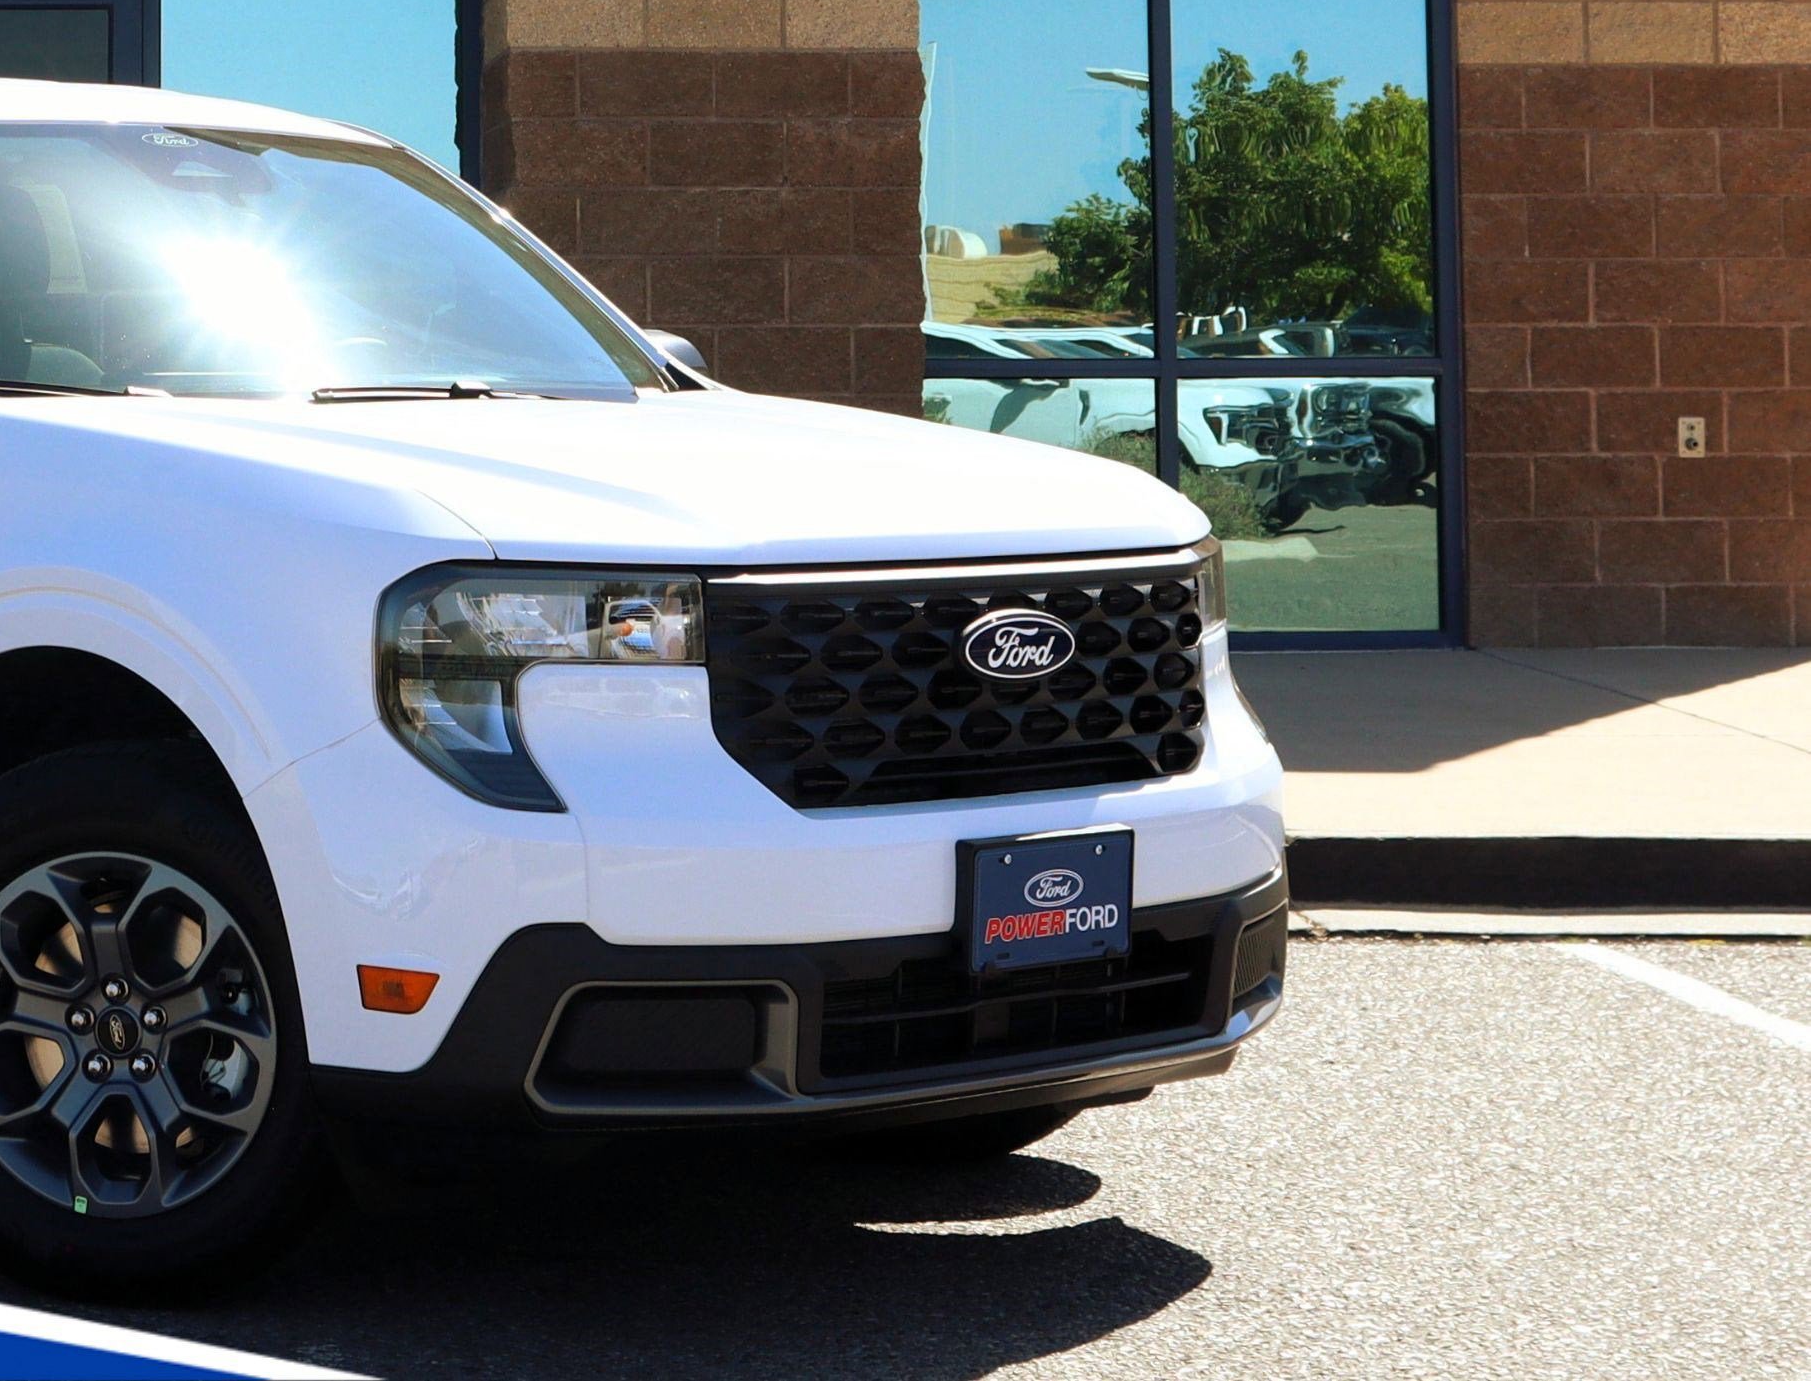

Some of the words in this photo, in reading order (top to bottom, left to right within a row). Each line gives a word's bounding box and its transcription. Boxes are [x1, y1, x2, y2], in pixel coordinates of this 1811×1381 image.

[988, 626, 1053, 669] Ford
[1036, 875, 1072, 900] Ford
[985, 903, 1119, 945] POWERFORD
